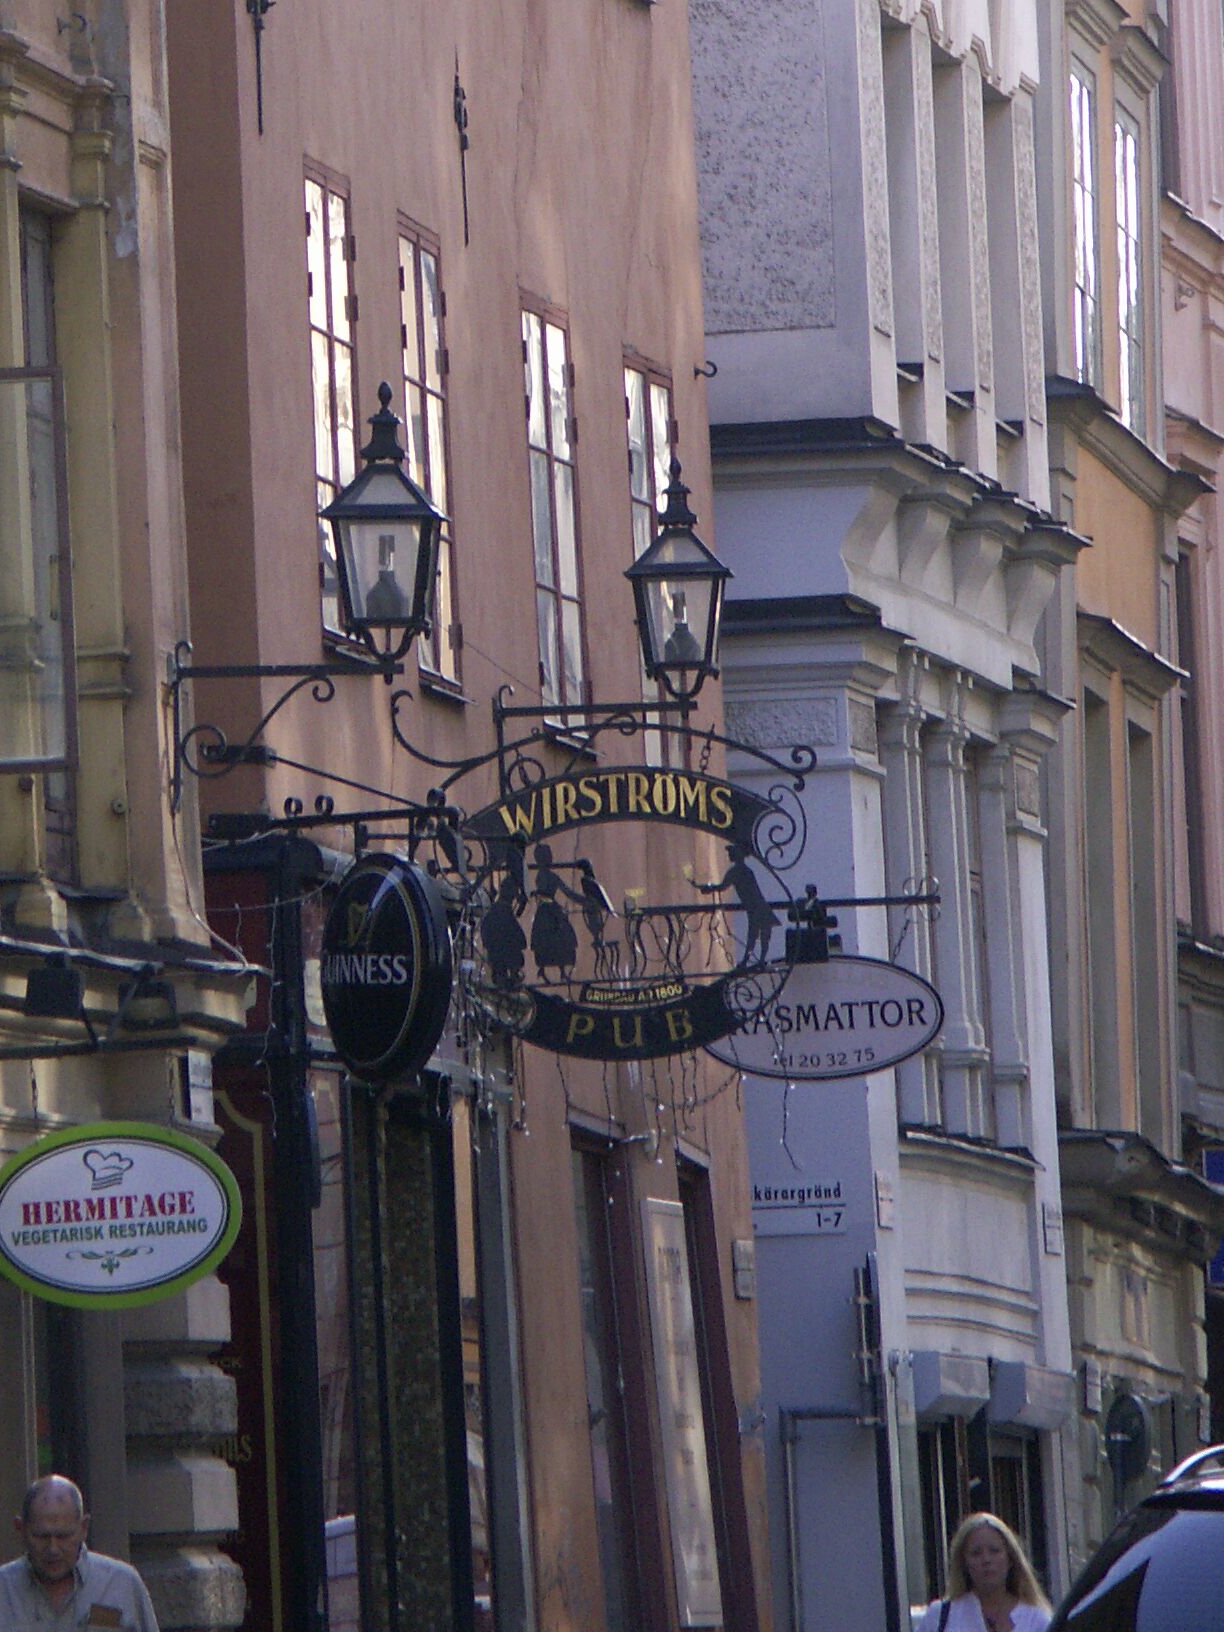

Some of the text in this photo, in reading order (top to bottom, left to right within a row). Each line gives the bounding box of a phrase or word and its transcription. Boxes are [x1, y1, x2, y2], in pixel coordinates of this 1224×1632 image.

[498, 772, 733, 837] WIRSTRÖMS
[566, 1008, 694, 1048] PUB
[799, 1054, 821, 1068] 20
[825, 1051, 847, 1067] 32
[853, 1048, 875, 1063] 75
[21, 1190, 196, 1226] HERMITAGE
[11, 1218, 208, 1246] VEGETARISK RESTAURANG
